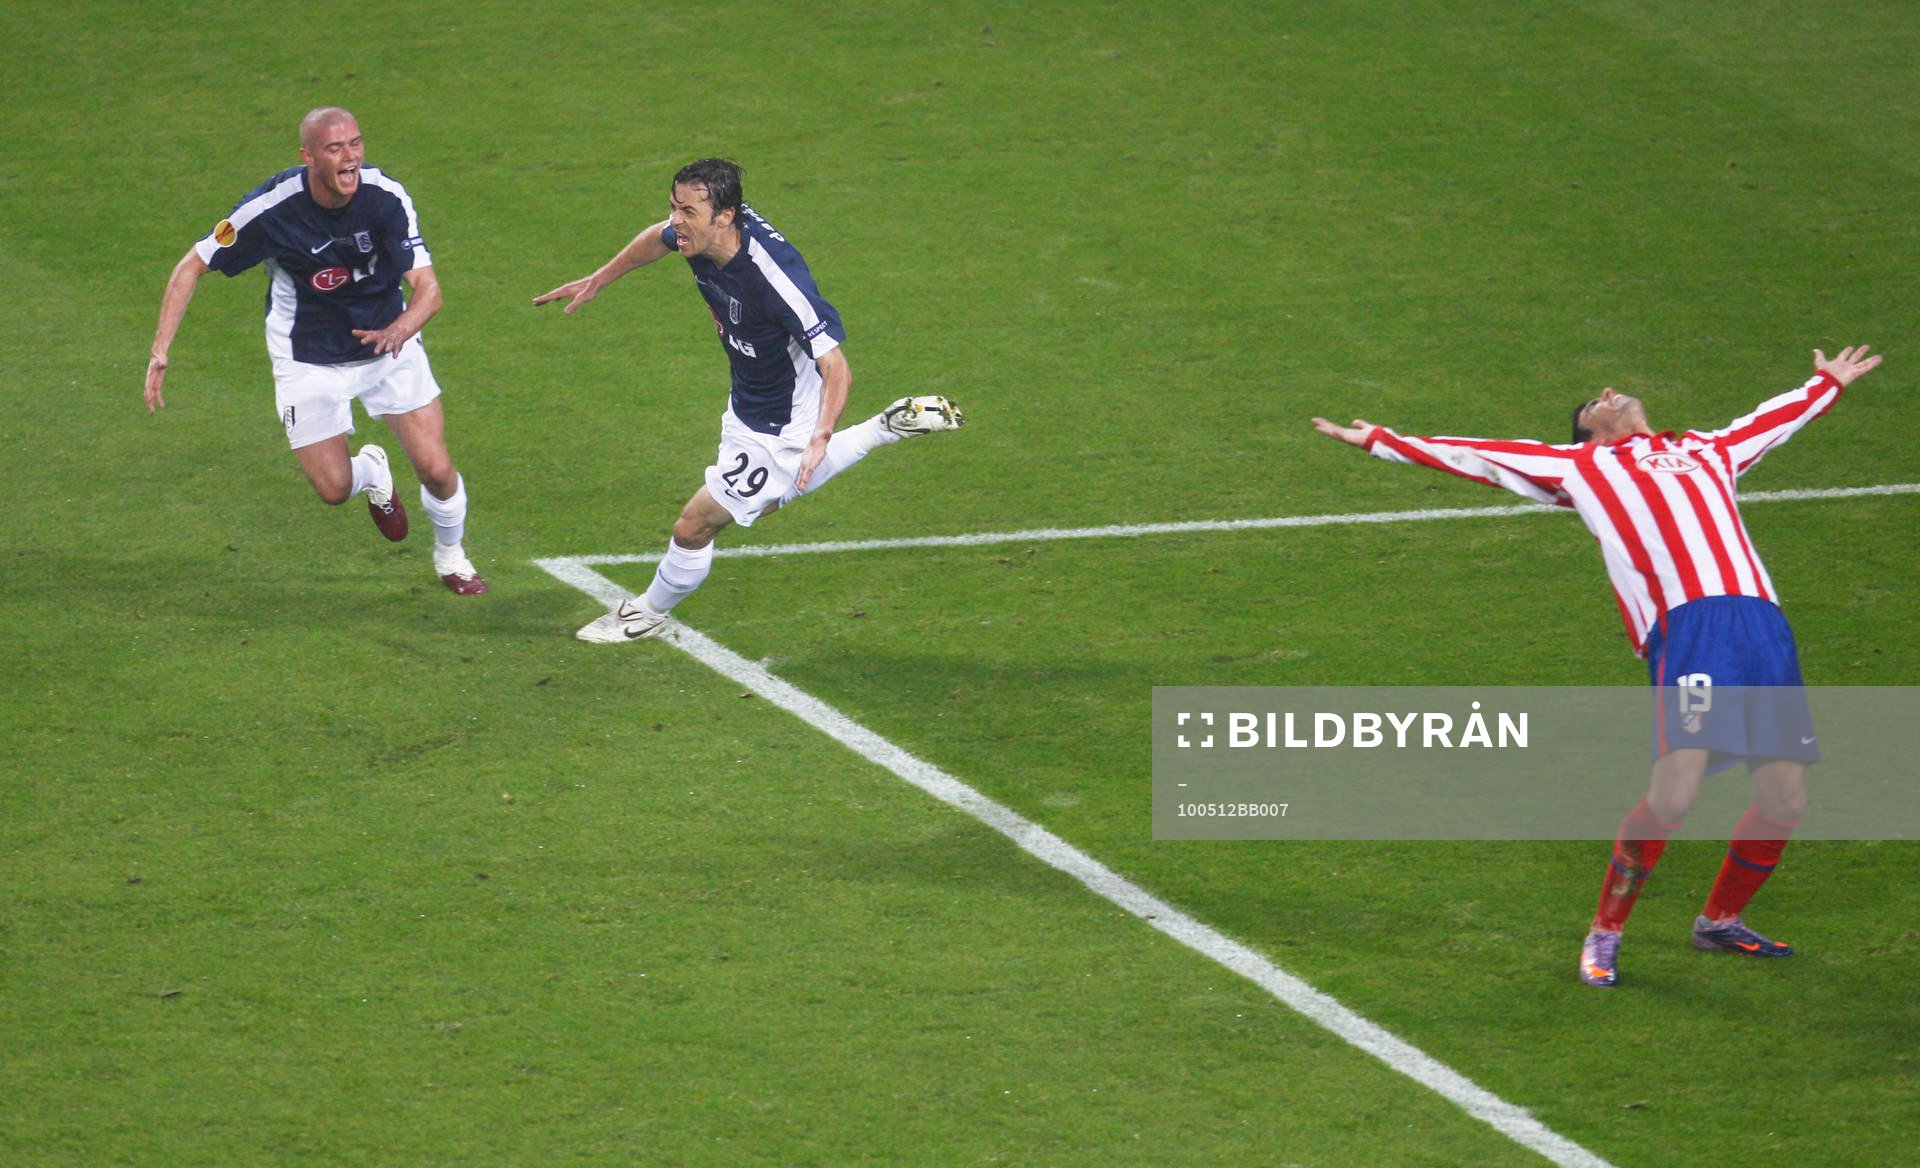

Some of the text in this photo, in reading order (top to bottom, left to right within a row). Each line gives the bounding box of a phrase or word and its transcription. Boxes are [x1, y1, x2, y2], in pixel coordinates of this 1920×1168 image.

[729, 334, 757, 358] LG
[722, 452, 769, 498] 29
[1645, 458, 1693, 470] KIA
[1677, 672, 1712, 713] 19
